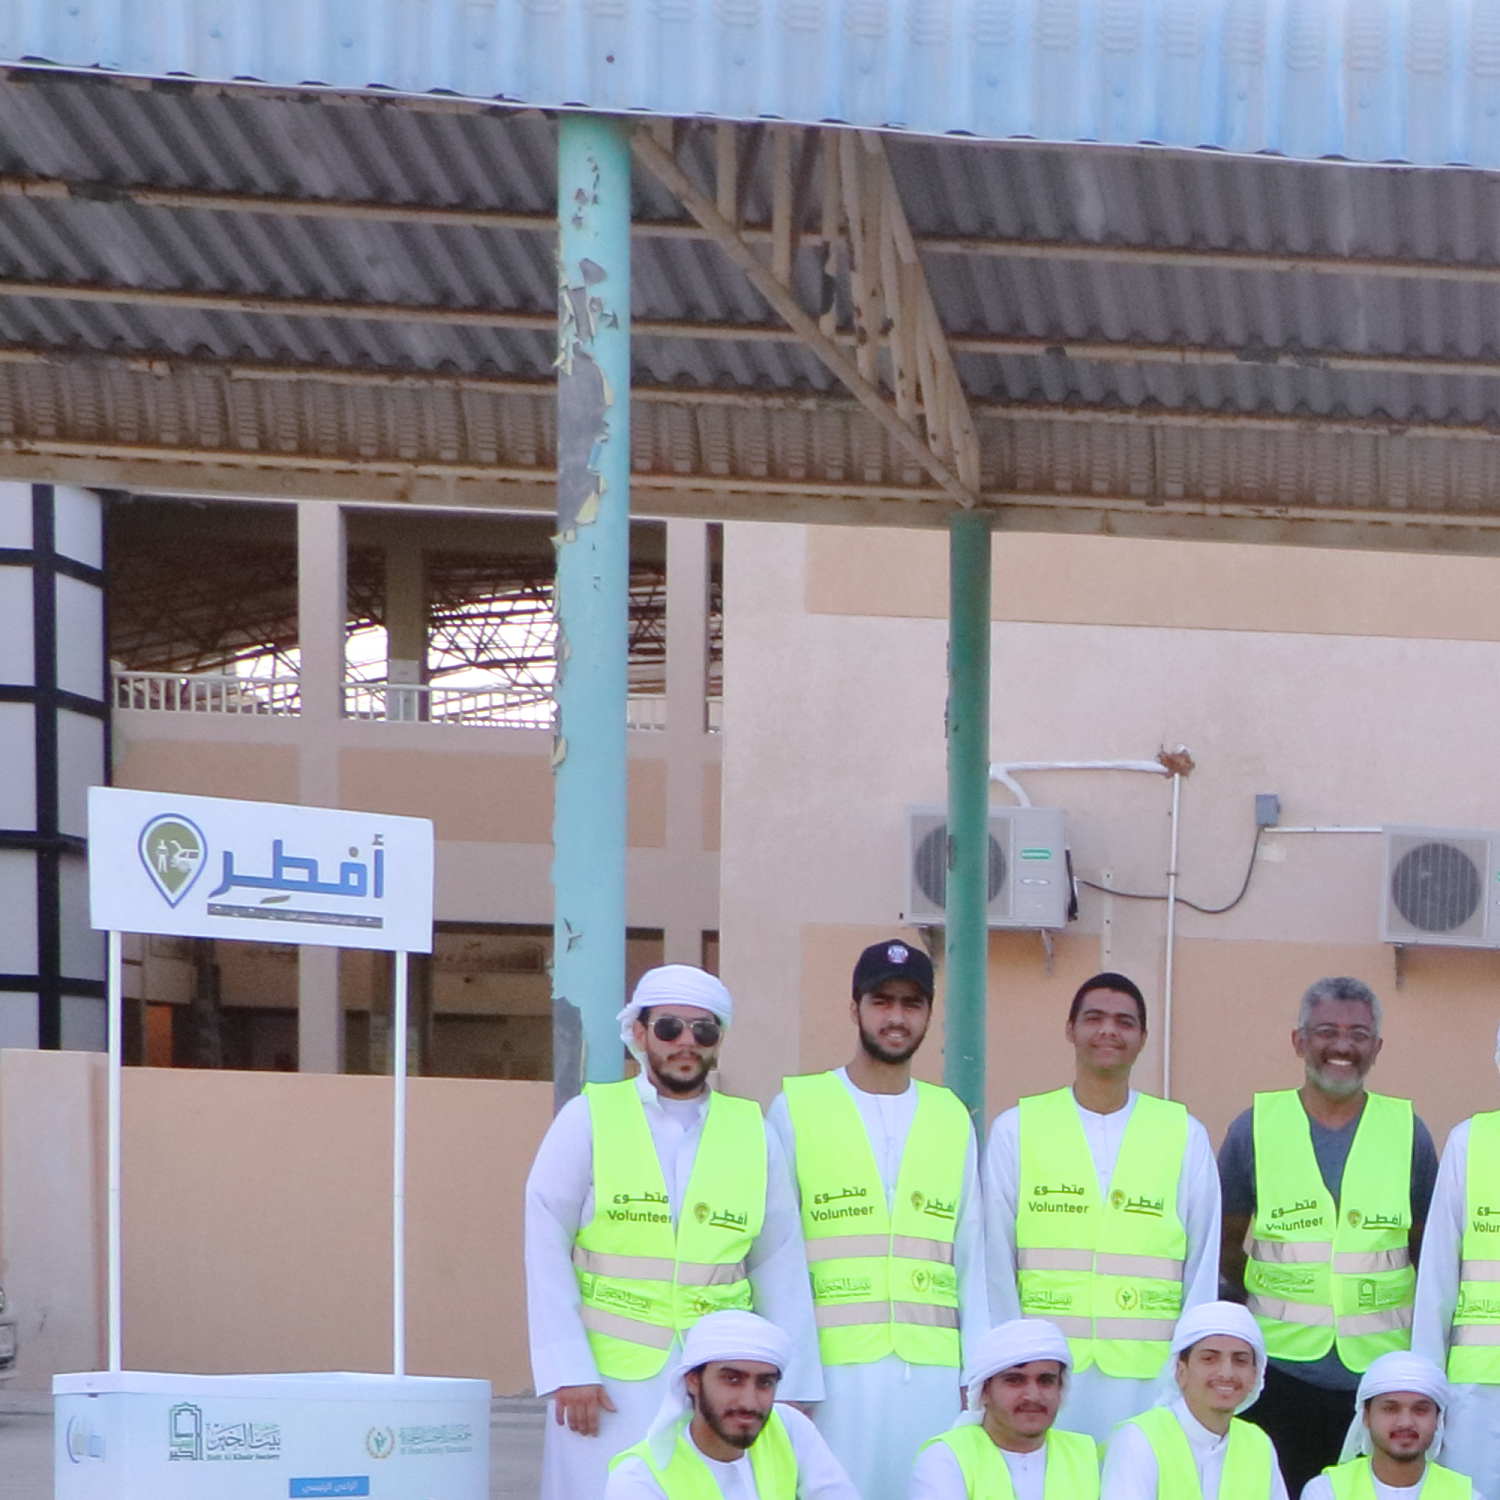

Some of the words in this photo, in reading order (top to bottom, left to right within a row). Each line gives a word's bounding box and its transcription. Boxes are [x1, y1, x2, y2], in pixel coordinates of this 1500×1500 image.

[814, 1186, 867, 1204] متطوع
[1034, 1183, 1084, 1196] متطوع
[613, 1191, 669, 1204] متطوع
[810, 1205, 875, 1221] Volunteer
[1028, 1201, 1089, 1214] Volunteer
[1271, 1199, 1317, 1218] متطوع
[1265, 1216, 1324, 1231] Volunteer
